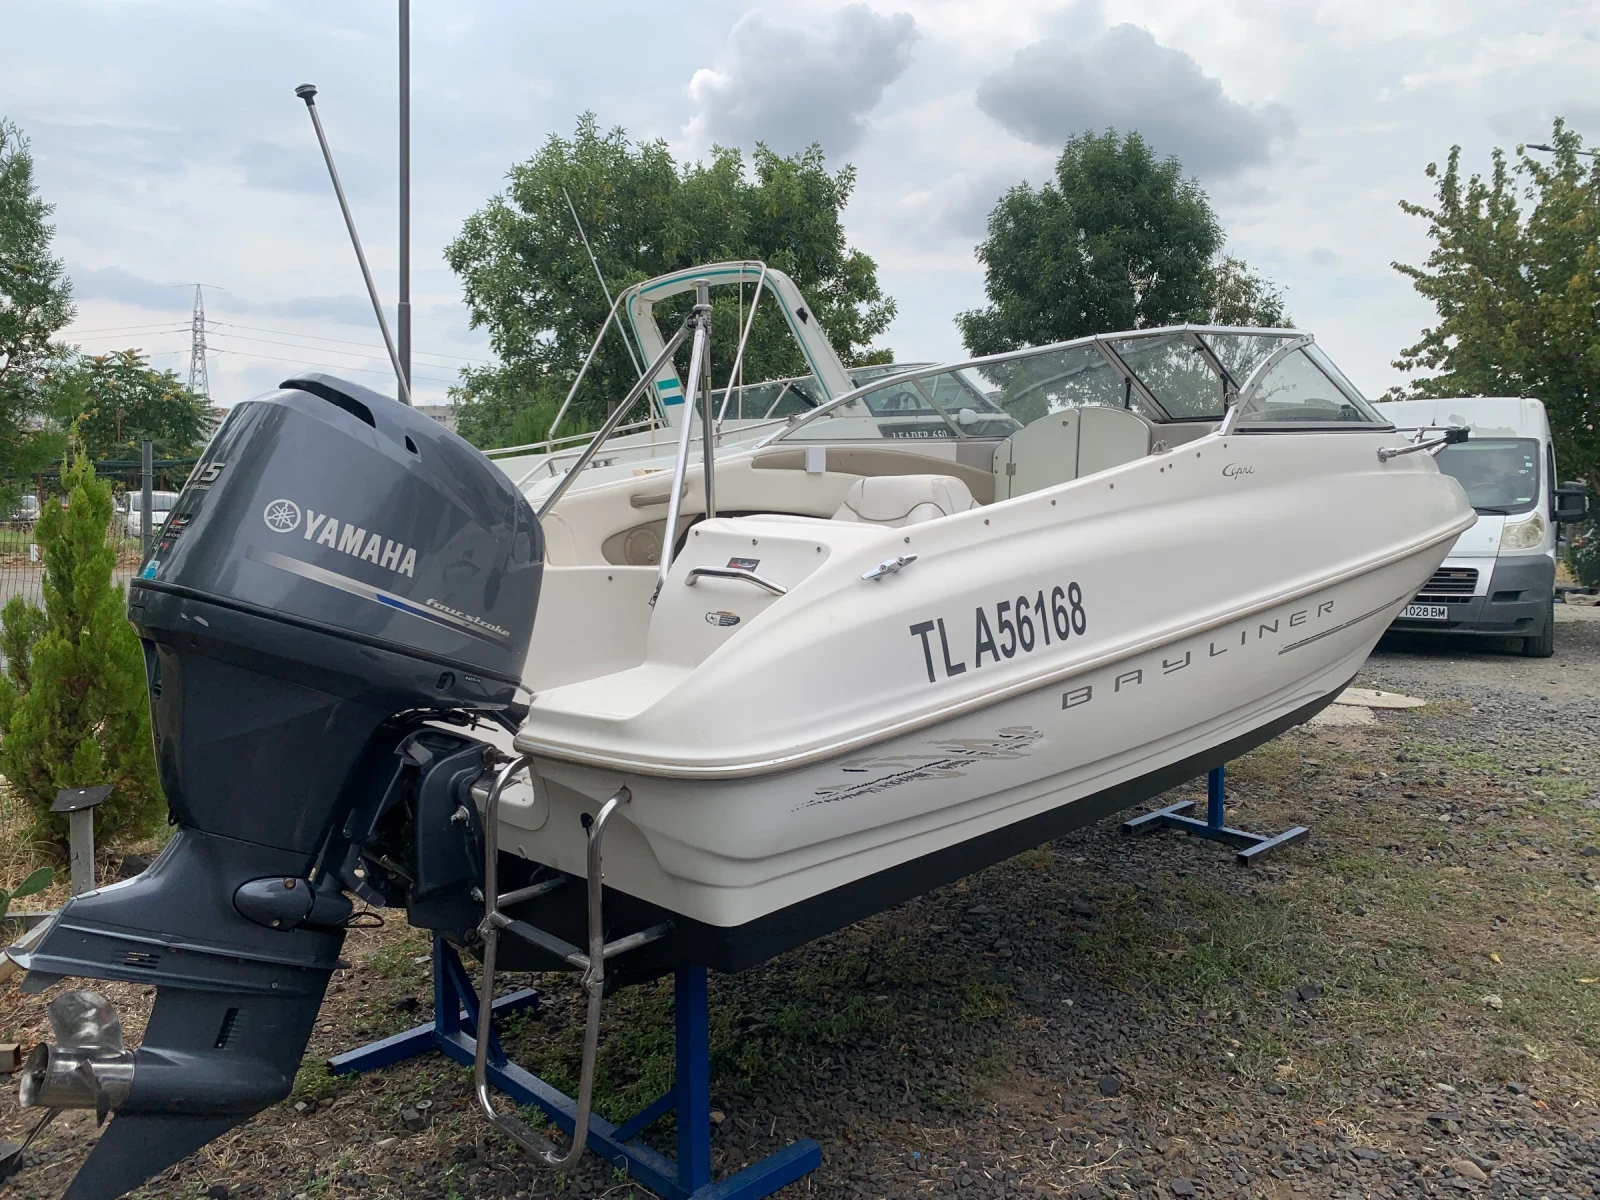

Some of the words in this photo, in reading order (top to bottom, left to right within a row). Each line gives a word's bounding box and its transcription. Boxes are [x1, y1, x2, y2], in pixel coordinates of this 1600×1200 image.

[1222, 462, 1256, 480] Capri
[303, 509, 417, 578] YAMAHA
[909, 617, 967, 684] TL
[975, 581, 1087, 669] A56168
[1405, 606, 1429, 617] 1028
[1431, 607, 1446, 618] BM
[1062, 600, 1334, 711] BAYLINER
